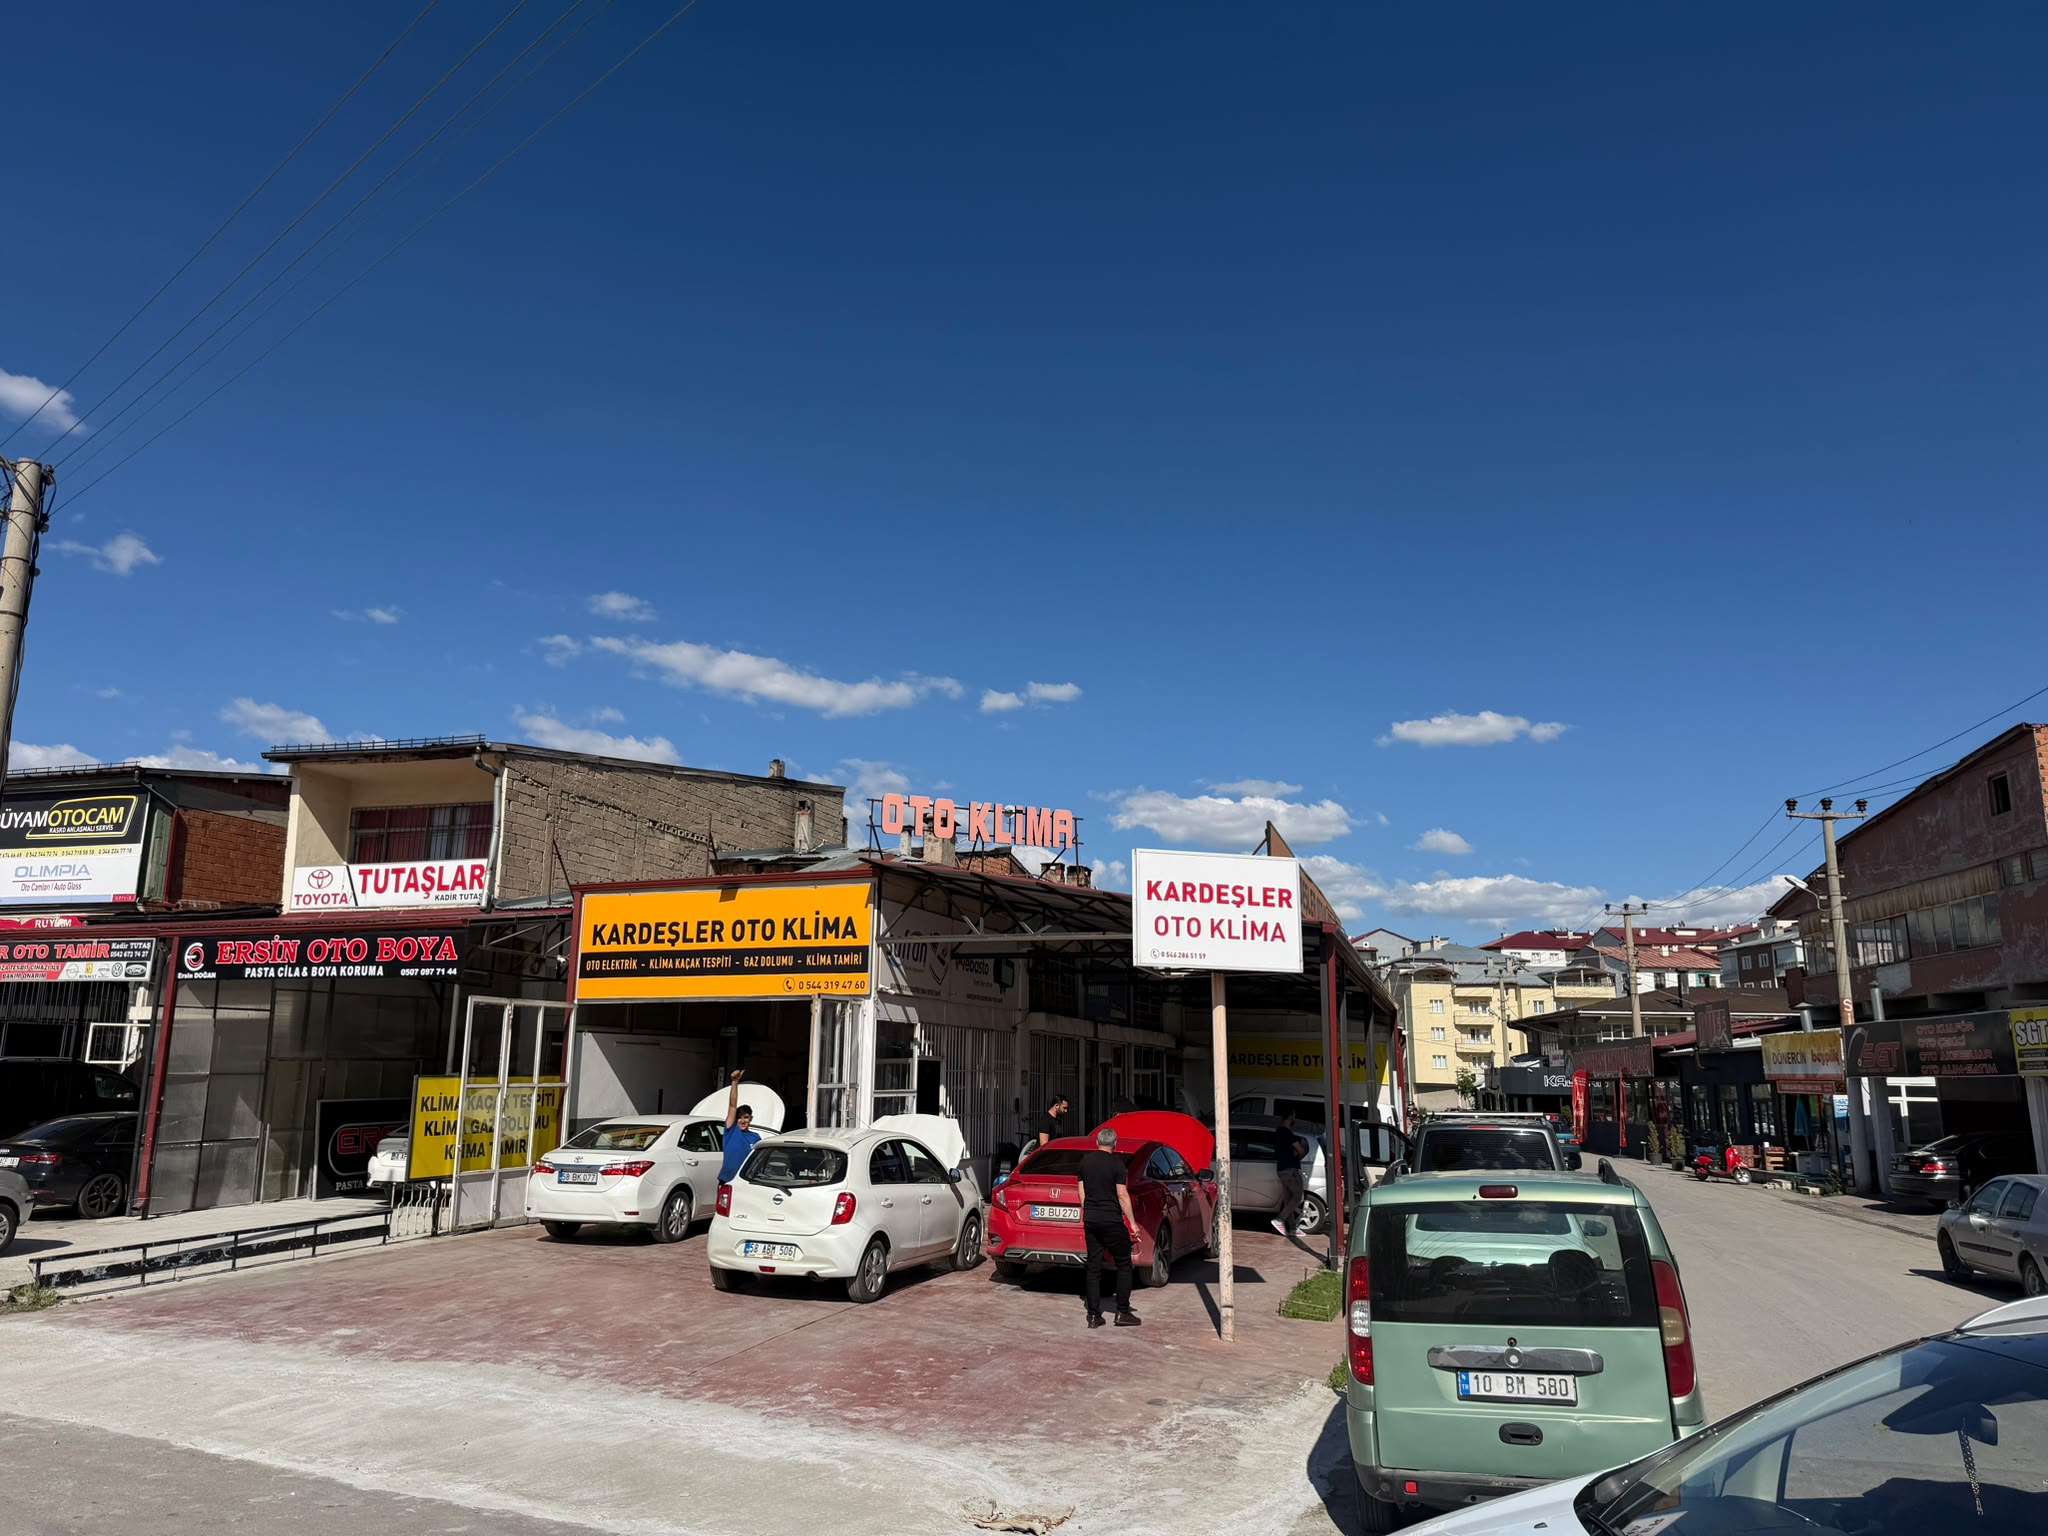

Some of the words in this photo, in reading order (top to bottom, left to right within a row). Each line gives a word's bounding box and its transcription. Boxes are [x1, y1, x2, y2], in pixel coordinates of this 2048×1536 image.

[881, 793, 955, 839] OTO
[54, 882, 67, 891] Auto
[67, 881, 82, 891] Glass
[358, 864, 485, 899] TUTAŞLAR
[294, 892, 349, 907] TOYOTA
[434, 892, 457, 901] KADİR
[1146, 880, 1293, 909] KARDEŞLER
[592, 919, 724, 947] KARDEŞLER
[731, 918, 775, 942] OTO
[782, 910, 857, 940] KLİMA
[1154, 915, 1202, 938] OTO
[1210, 914, 1287, 943] KLİMA
[13, 944, 50, 960] OTO
[54, 940, 111, 959] TAMİR
[215, 935, 300, 965] ERSİN
[307, 938, 368, 963] OTO
[375, 936, 458, 962] BOYA
[586, 960, 600, 971] OTO
[602, 957, 638, 971] ELEKTRİK
[649, 956, 674, 969] KLİMA
[675, 957, 700, 970] KAÇAK
[702, 955, 732, 968] TESPİTİ
[744, 956, 759, 967] GAZ
[761, 955, 794, 967] DOLUMU
[806, 952, 832, 966] KLİMA
[834, 952, 862, 966] TAMİRİ
[245, 967, 275, 978] PASTA
[277, 965, 300, 977] CİLA
[301, 967, 309, 977] &
[311, 966, 337, 977] BOYA
[340, 965, 384, 977] KORUMA
[400, 968, 419, 976] 0507
[420, 968, 435, 976] 097
[798, 981, 804, 990] 0
[806, 980, 821, 990] 544
[824, 980, 840, 990] 319
[842, 980, 853, 989] 47
[855, 980, 866, 989] 60
[1916, 1024, 1935, 1035] OTO
[1918, 1037, 1937, 1048] OTO
[1229, 1053, 1299, 1068] ARDEŞLER
[1919, 1051, 1938, 1061] OTO
[1921, 1064, 1940, 1075] OTO
[444, 1138, 486, 1160] KİMA
[572, 1173, 582, 1181] BK
[583, 1173, 596, 1182] 077
[335, 1180, 364, 1191] PASTA
[1035, 1207, 1046, 1217] 58
[1049, 1208, 1061, 1218] BU
[1062, 1208, 1079, 1218] 270
[750, 1243, 759, 1253] 58
[779, 1246, 794, 1256] 506
[1474, 1374, 1492, 1393] 10
[1505, 1376, 1526, 1395] BM
[1537, 1377, 1569, 1397] 580
